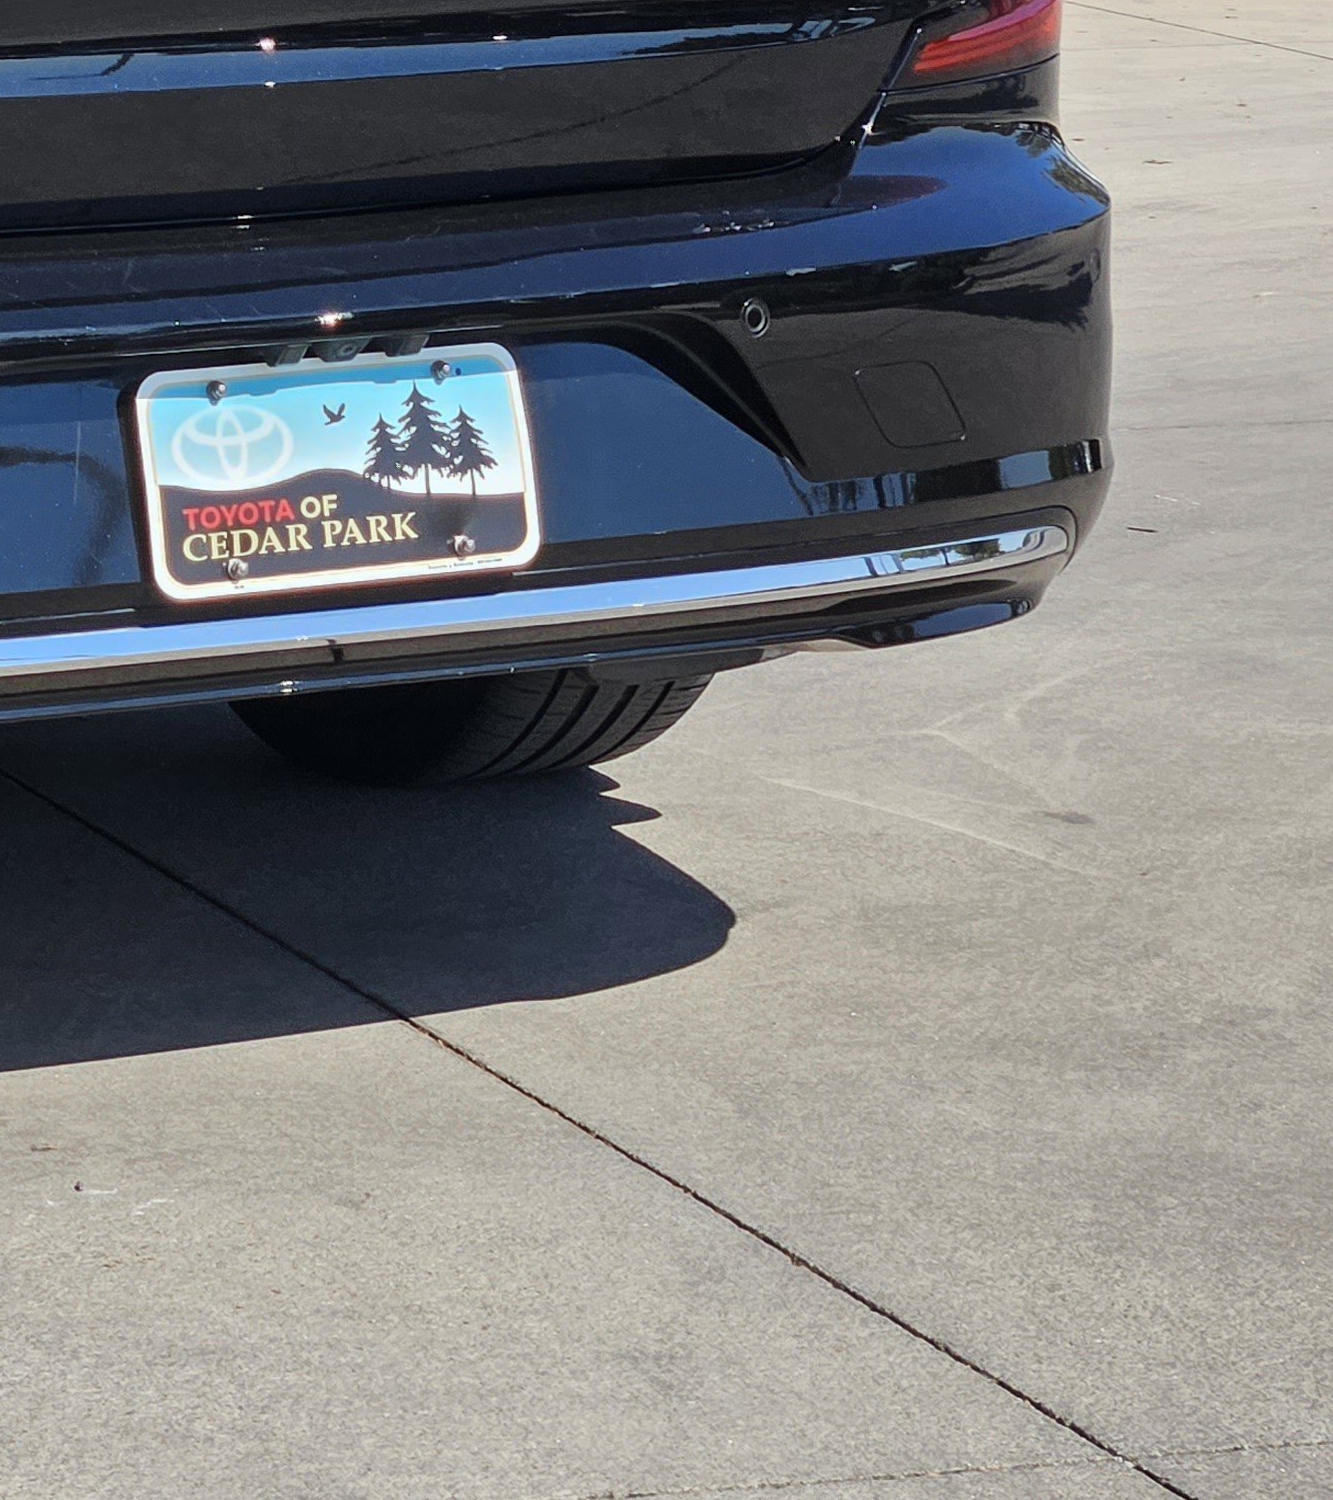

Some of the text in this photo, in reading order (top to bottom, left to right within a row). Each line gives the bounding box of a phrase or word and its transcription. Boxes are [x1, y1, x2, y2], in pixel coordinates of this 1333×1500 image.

[182, 494, 338, 531] TOYOTA OF
[183, 512, 419, 562] CEDAR PARK
